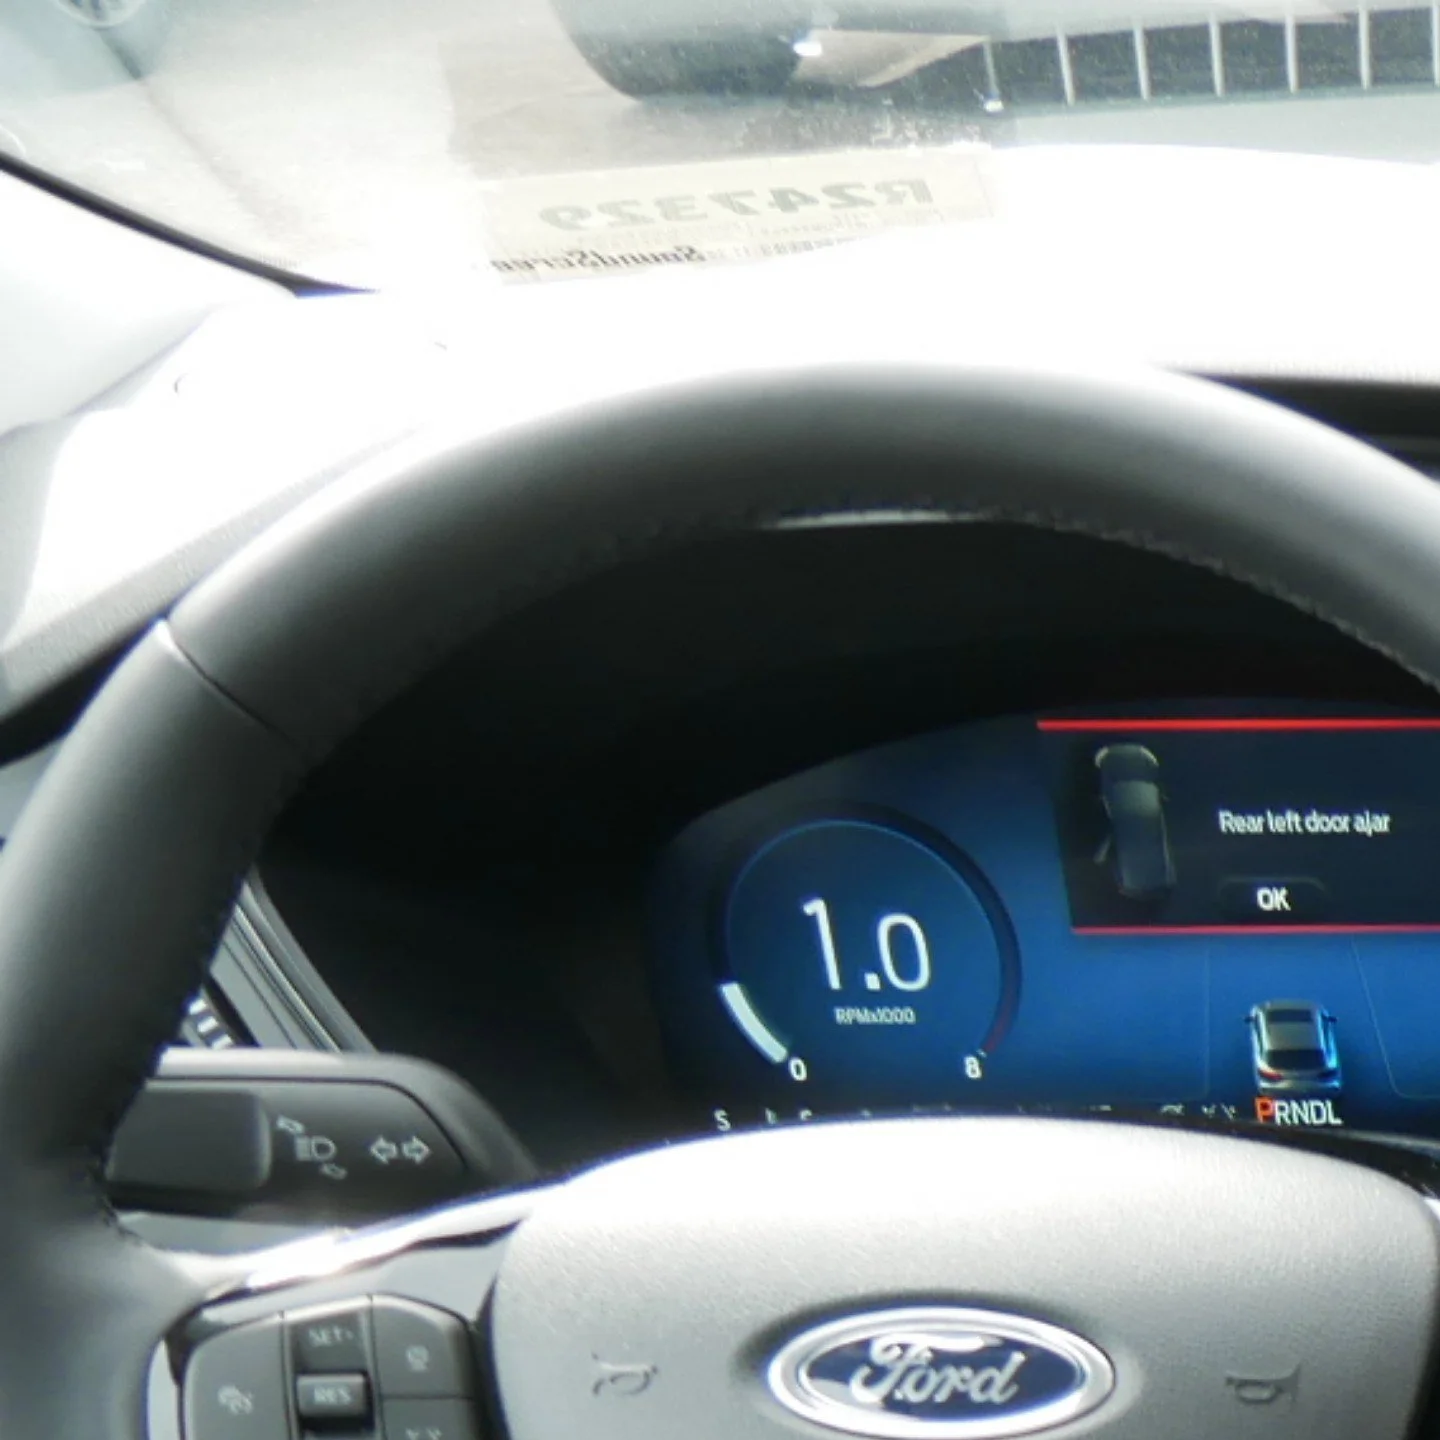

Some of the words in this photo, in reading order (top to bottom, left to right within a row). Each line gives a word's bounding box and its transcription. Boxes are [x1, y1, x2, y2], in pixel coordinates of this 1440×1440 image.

[1218, 810, 1264, 833] Rear
[1267, 810, 1302, 833] left
[1305, 810, 1350, 833] door
[1353, 810, 1391, 838] ajar
[1256, 886, 1291, 911] OK
[803, 897, 932, 992] 1.0
[788, 1057, 808, 1081] 0
[965, 1055, 982, 1079] 8
[849, 1332, 1026, 1405] Ford
[312, 1386, 352, 1405] RES
